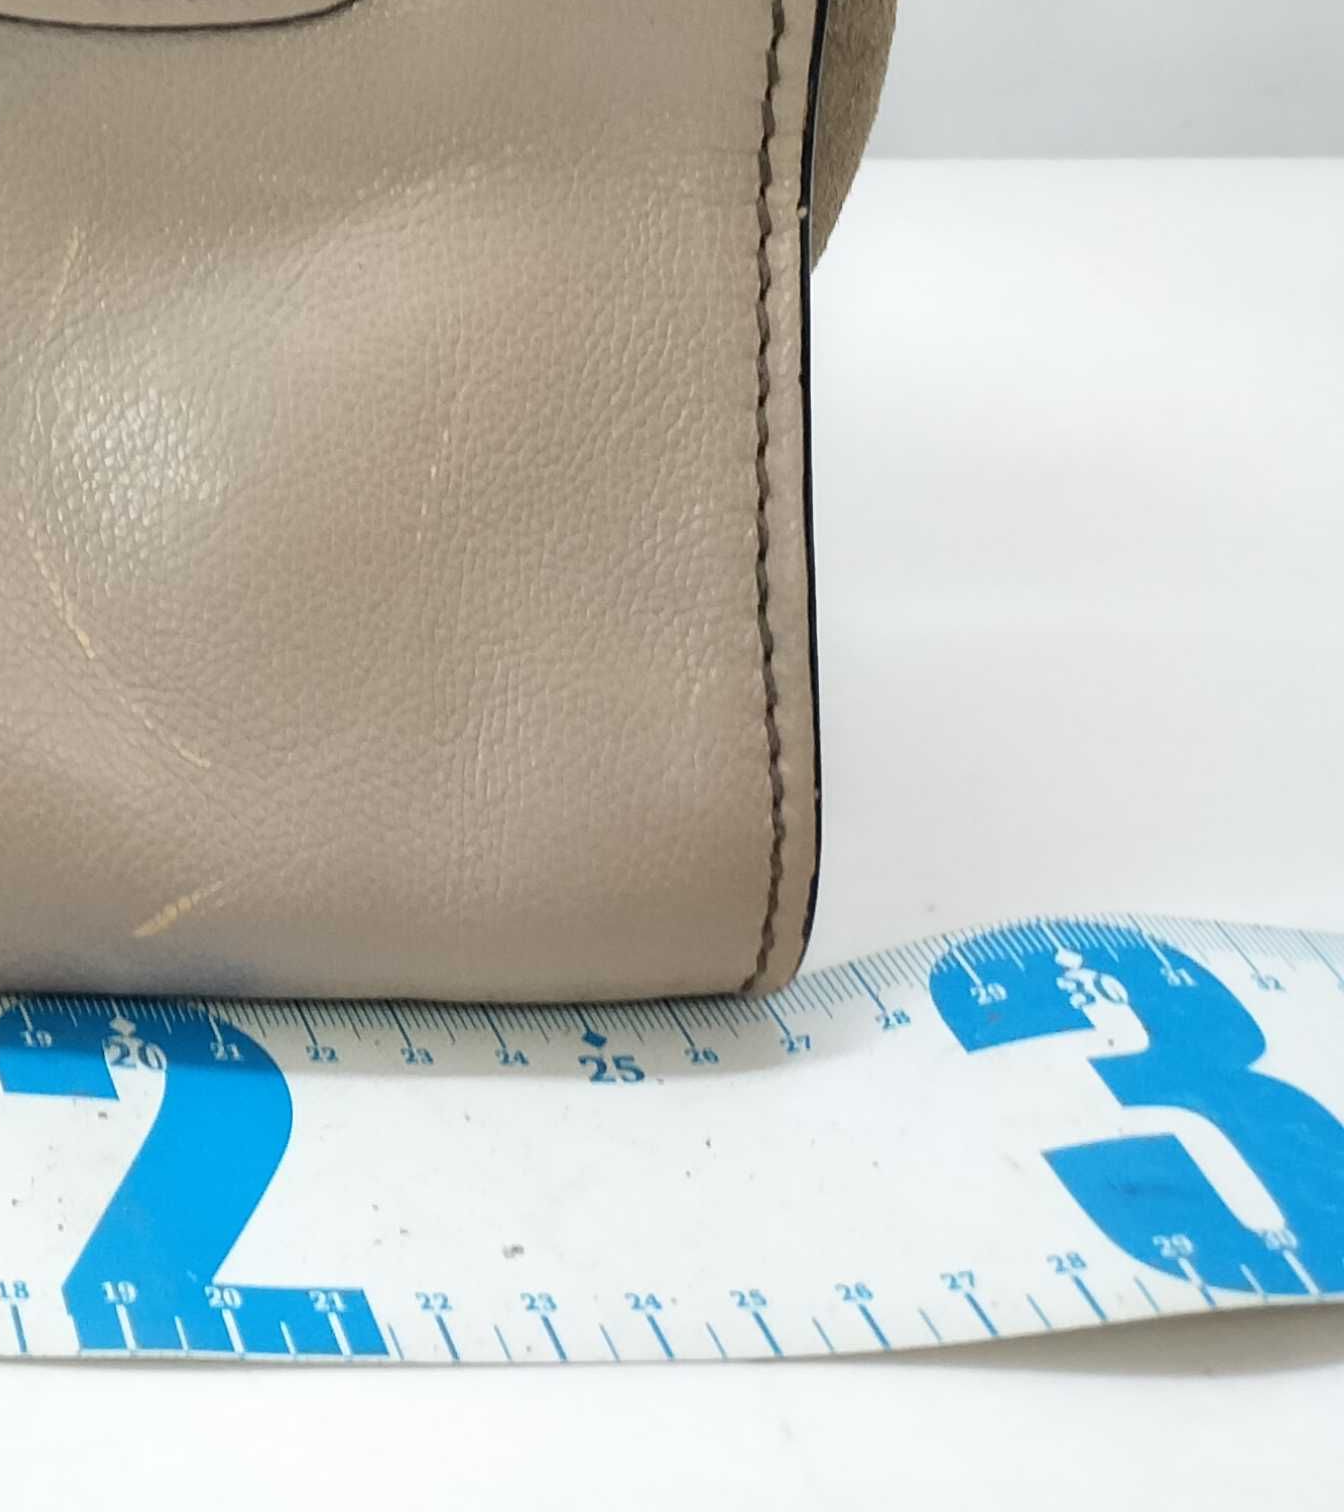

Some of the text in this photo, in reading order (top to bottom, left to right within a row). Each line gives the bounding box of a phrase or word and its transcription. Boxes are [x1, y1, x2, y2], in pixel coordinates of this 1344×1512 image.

[20, 1030, 54, 1047] 19
[105, 1037, 168, 1071] 20
[210, 1043, 245, 1062] 21
[305, 1045, 340, 1063] 22
[401, 1047, 434, 1065] 23
[496, 1049, 529, 1066] 24
[578, 1055, 646, 1083] 25
[685, 1045, 719, 1065] 26
[781, 1032, 812, 1055] 27
[875, 1010, 911, 1031] 28
[971, 984, 1008, 1005] 29
[1056, 969, 1128, 1010] 30
[929, 920, 1344, 1296] 3
[101, 1282, 137, 1304] 19
[206, 1286, 242, 1309] 20
[309, 1290, 346, 1312] 21
[416, 1293, 453, 1311] 22
[521, 1293, 558, 1312] 23
[625, 1291, 663, 1311] 24
[731, 1290, 767, 1309] 25
[835, 1282, 873, 1303] 26
[940, 1270, 976, 1291] 27
[1047, 1252, 1087, 1275] 28
[1152, 1234, 1193, 1257] 29
